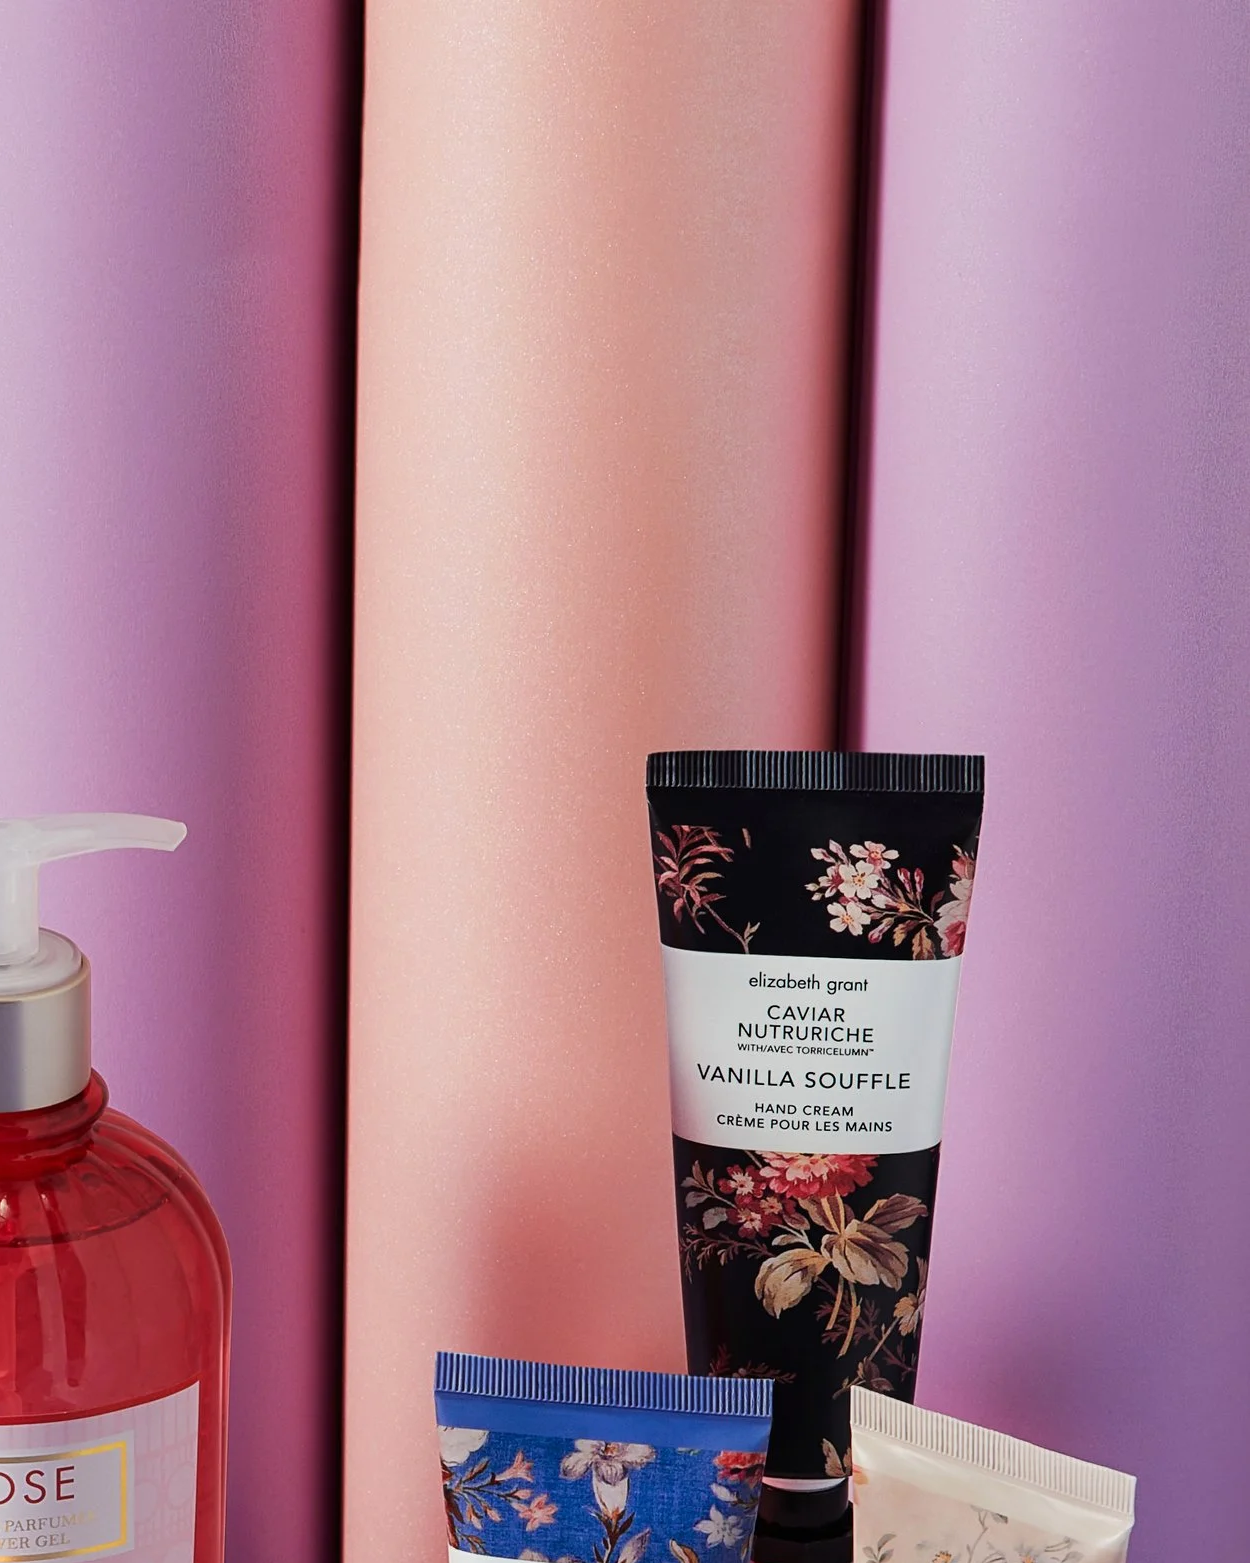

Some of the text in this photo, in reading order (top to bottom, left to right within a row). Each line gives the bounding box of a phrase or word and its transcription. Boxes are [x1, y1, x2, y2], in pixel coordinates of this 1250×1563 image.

[749, 972, 868, 995] elizabeth grant
[767, 1005, 845, 1022] CAVIAR
[738, 1023, 873, 1042] NUTRURICHE
[737, 1043, 793, 1054] WITH/AVEC
[697, 1063, 911, 1089] VANILLA SOUFFLE
[755, 1103, 854, 1116] HAND CREAM
[717, 1114, 893, 1132] CRÈME POUR LES MAINS
[35, 1533, 71, 1548] GEL
